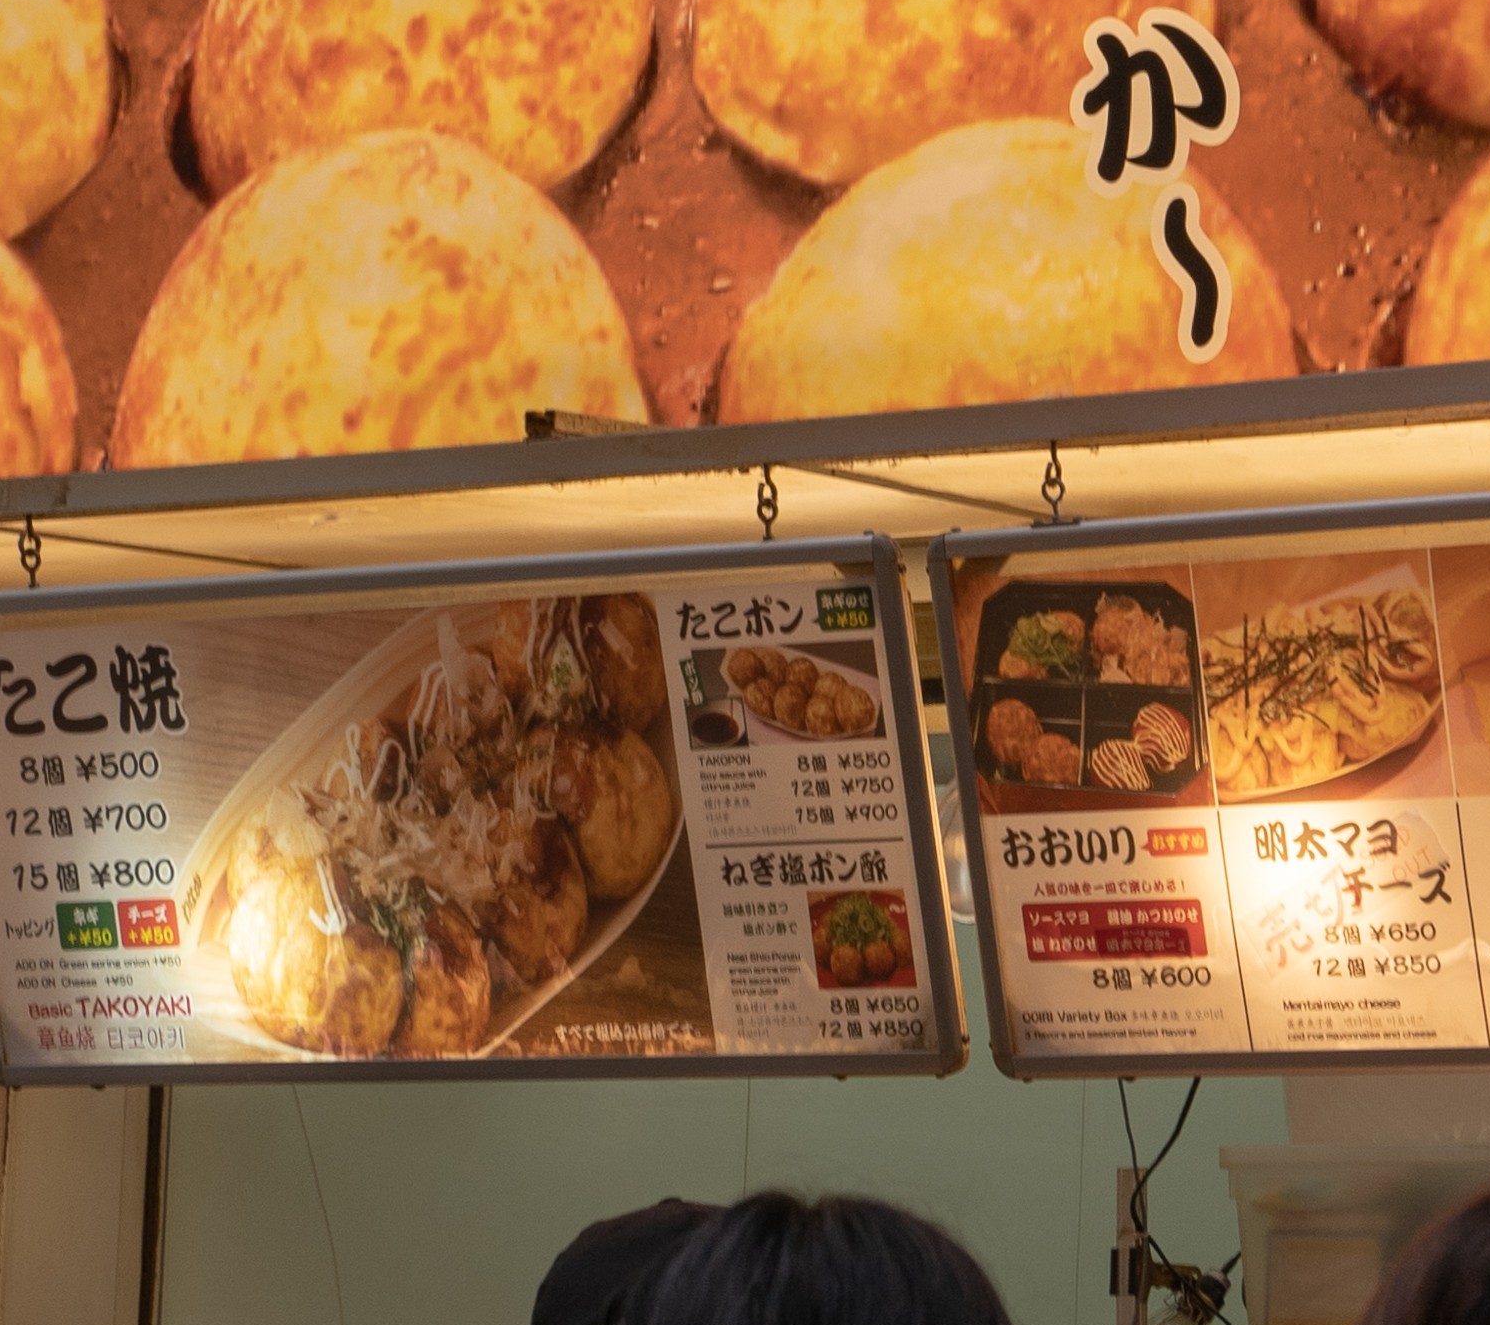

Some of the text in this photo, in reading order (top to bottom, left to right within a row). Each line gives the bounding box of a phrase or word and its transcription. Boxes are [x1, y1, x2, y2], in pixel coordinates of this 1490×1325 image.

[676, 594, 804, 641] たこポン
[20, 751, 159, 786] 8個 ¥500
[797, 751, 891, 774] 8個 ¥550
[791, 777, 894, 799] 12個 ¥750
[6, 803, 167, 838] 12個 ¥700
[795, 804, 898, 825] 15個 ¥900
[1001, 825, 1137, 868] おおいり
[1254, 818, 1398, 863] 明太マヨ
[13, 859, 175, 893] 15個 ¥800
[722, 850, 889, 887] ねぎ塩ポン酢
[1342, 859, 1453, 908] チーズ
[127, 905, 168, 924] チーズ
[5, 918, 55, 941] トッピング
[1325, 922, 1436, 945] 8個 ¥650
[1092, 966, 1212, 991] 8個 ¥600
[1313, 955, 1442, 978] 12個 ¥850
[28, 995, 192, 1020] Basic TAKOYAKI
[830, 996, 919, 1015] 8個 ¥650
[1104, 1009, 1128, 1022] Box
[107, 1026, 186, 1051] 타코야키
[819, 1021, 863, 1039] 12個
[869, 1020, 924, 1038] ¥850
